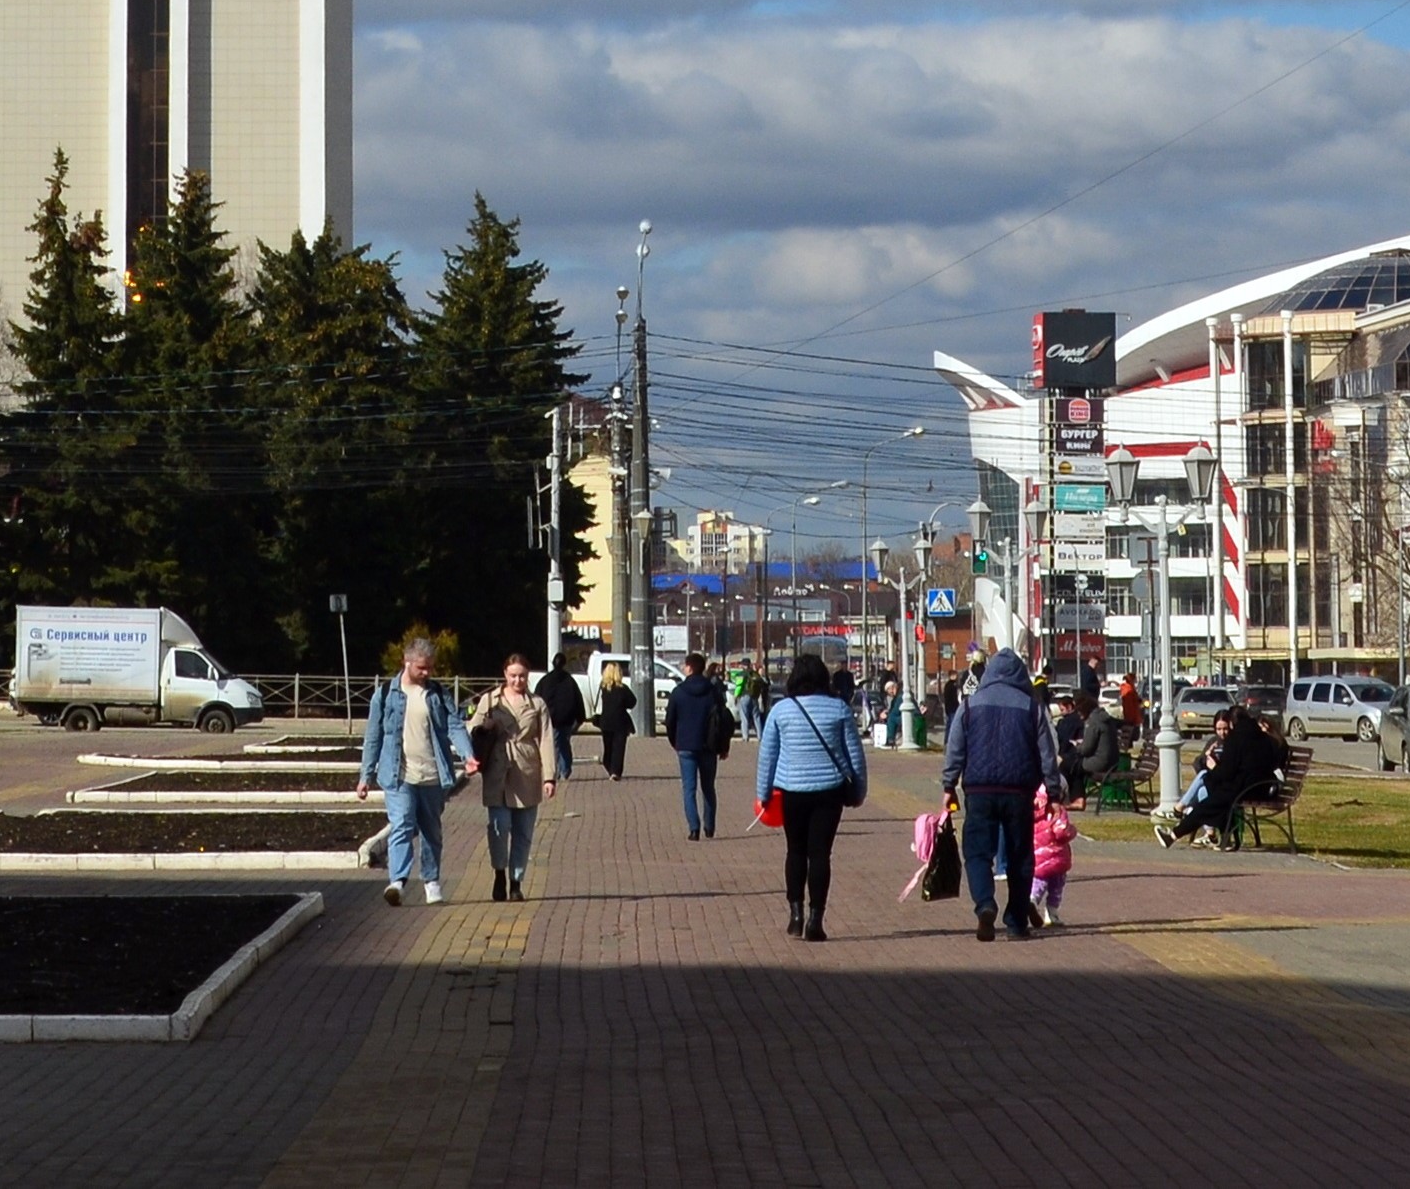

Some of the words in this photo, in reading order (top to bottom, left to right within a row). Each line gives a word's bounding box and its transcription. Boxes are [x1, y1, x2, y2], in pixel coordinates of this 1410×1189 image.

[1061, 429, 1098, 439] БУРГЕР
[46, 628, 110, 642] Сервисный
[113, 632, 148, 644] центр
